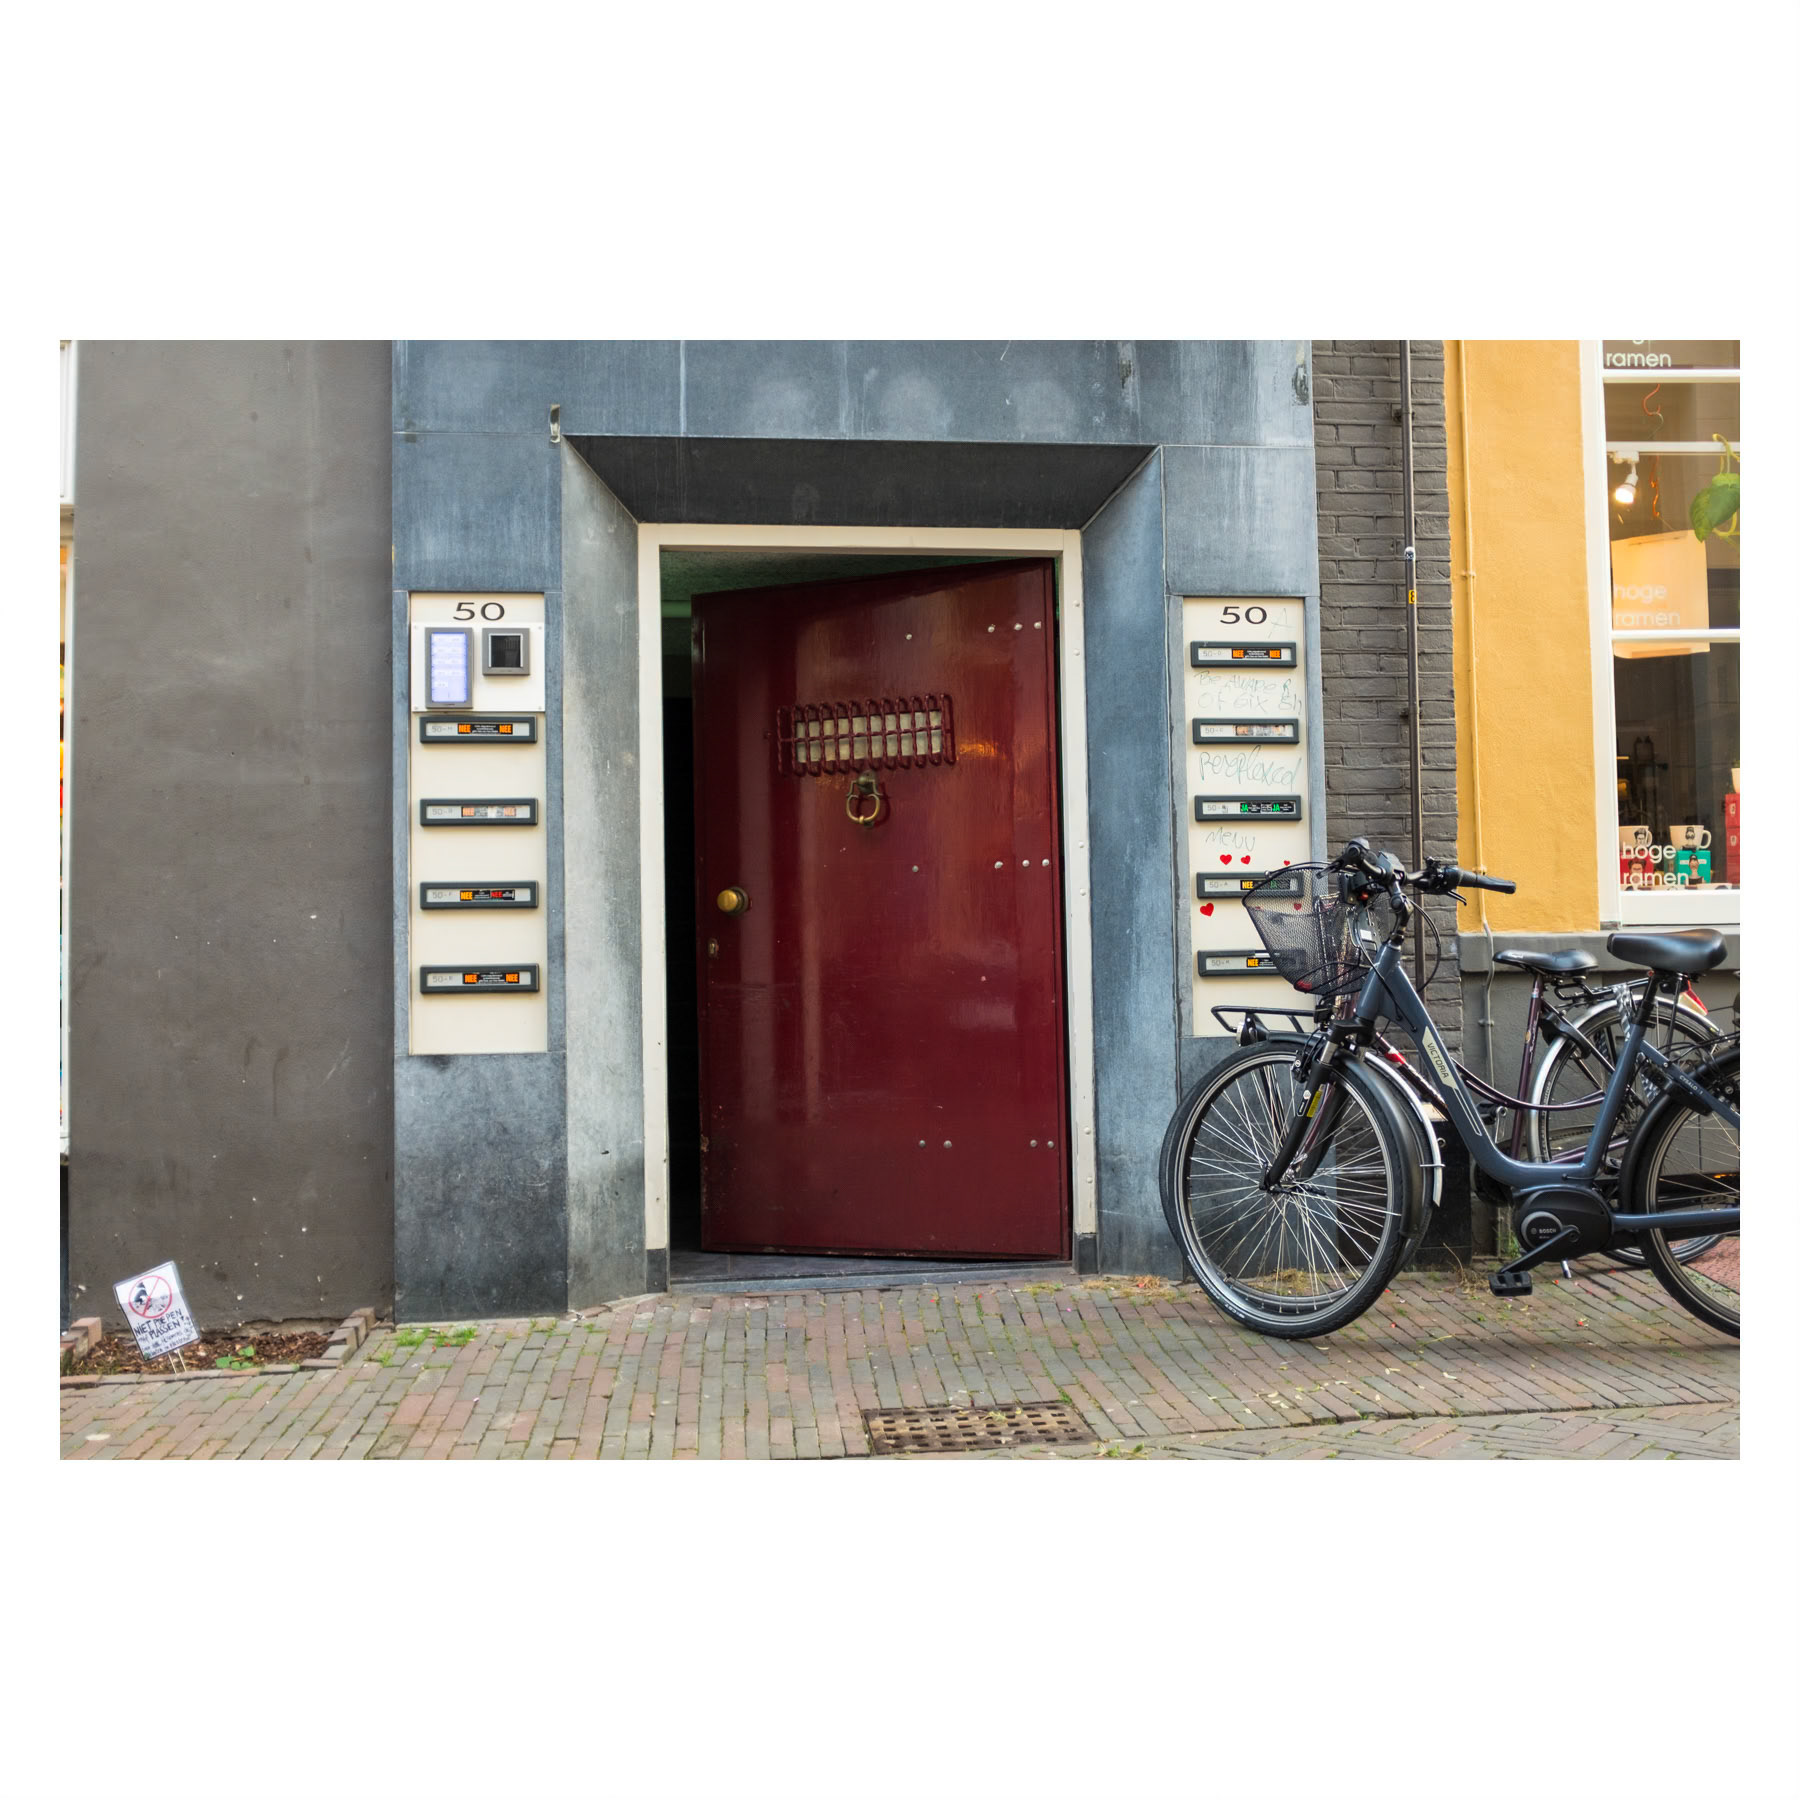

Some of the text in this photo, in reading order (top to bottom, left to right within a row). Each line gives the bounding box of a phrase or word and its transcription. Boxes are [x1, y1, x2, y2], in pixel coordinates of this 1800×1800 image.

[1607, 353, 1672, 367] ramen
[453, 602, 505, 621] 50
[1220, 606, 1267, 624] 50
[1615, 611, 1680, 627] ramen
[458, 724, 471, 733] NEE
[499, 724, 512, 734] NEE
[1240, 803, 1248, 812] JA
[1272, 803, 1280, 812] JA
[1622, 842, 1676, 863] hoge
[1242, 881, 1253, 889] NEE
[1623, 872, 1689, 886] ramen
[460, 891, 472, 900] NEE
[1247, 958, 1258, 966] NEE
[464, 974, 477, 983] NEE
[505, 973, 518, 982] NEE
[1427, 1042, 1449, 1079] VICTORIA
